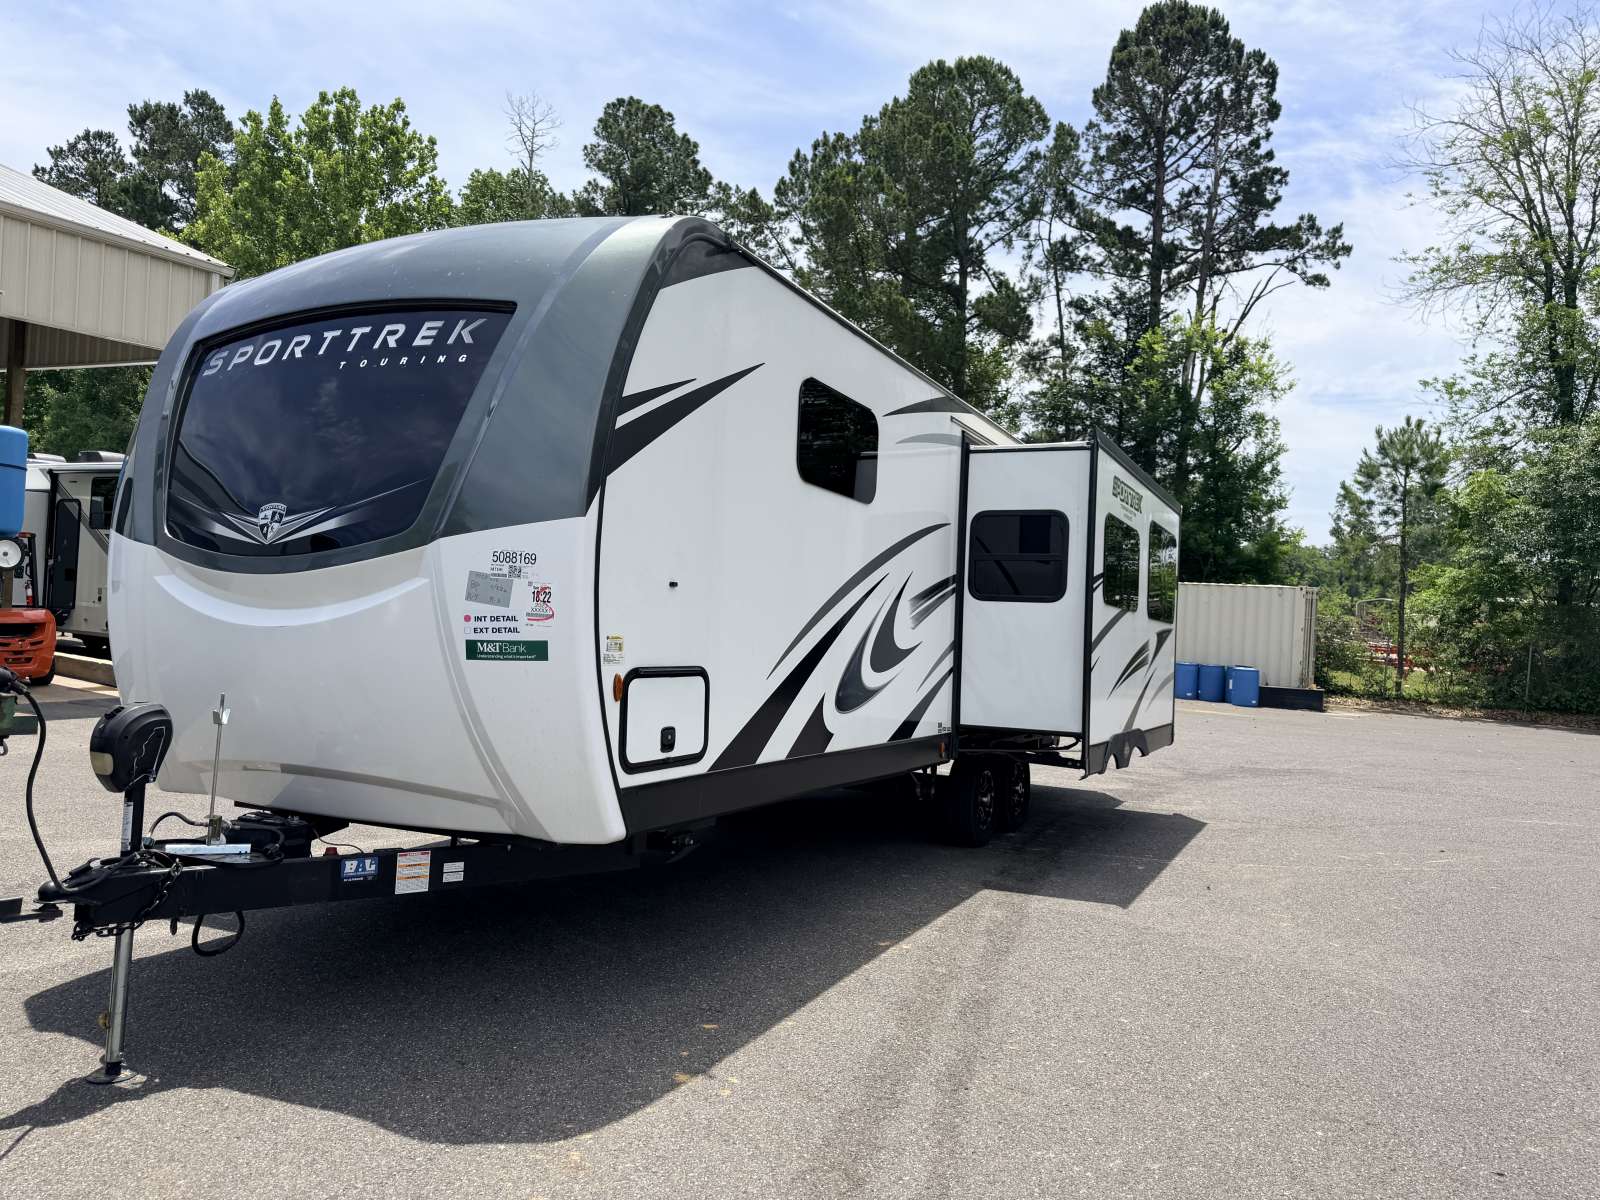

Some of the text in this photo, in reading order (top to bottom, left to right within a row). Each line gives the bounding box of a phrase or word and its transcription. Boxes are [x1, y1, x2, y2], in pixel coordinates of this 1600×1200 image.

[202, 318, 488, 377] SPORTTREK
[338, 353, 468, 370] TOURING
[492, 551, 537, 565] 5088169
